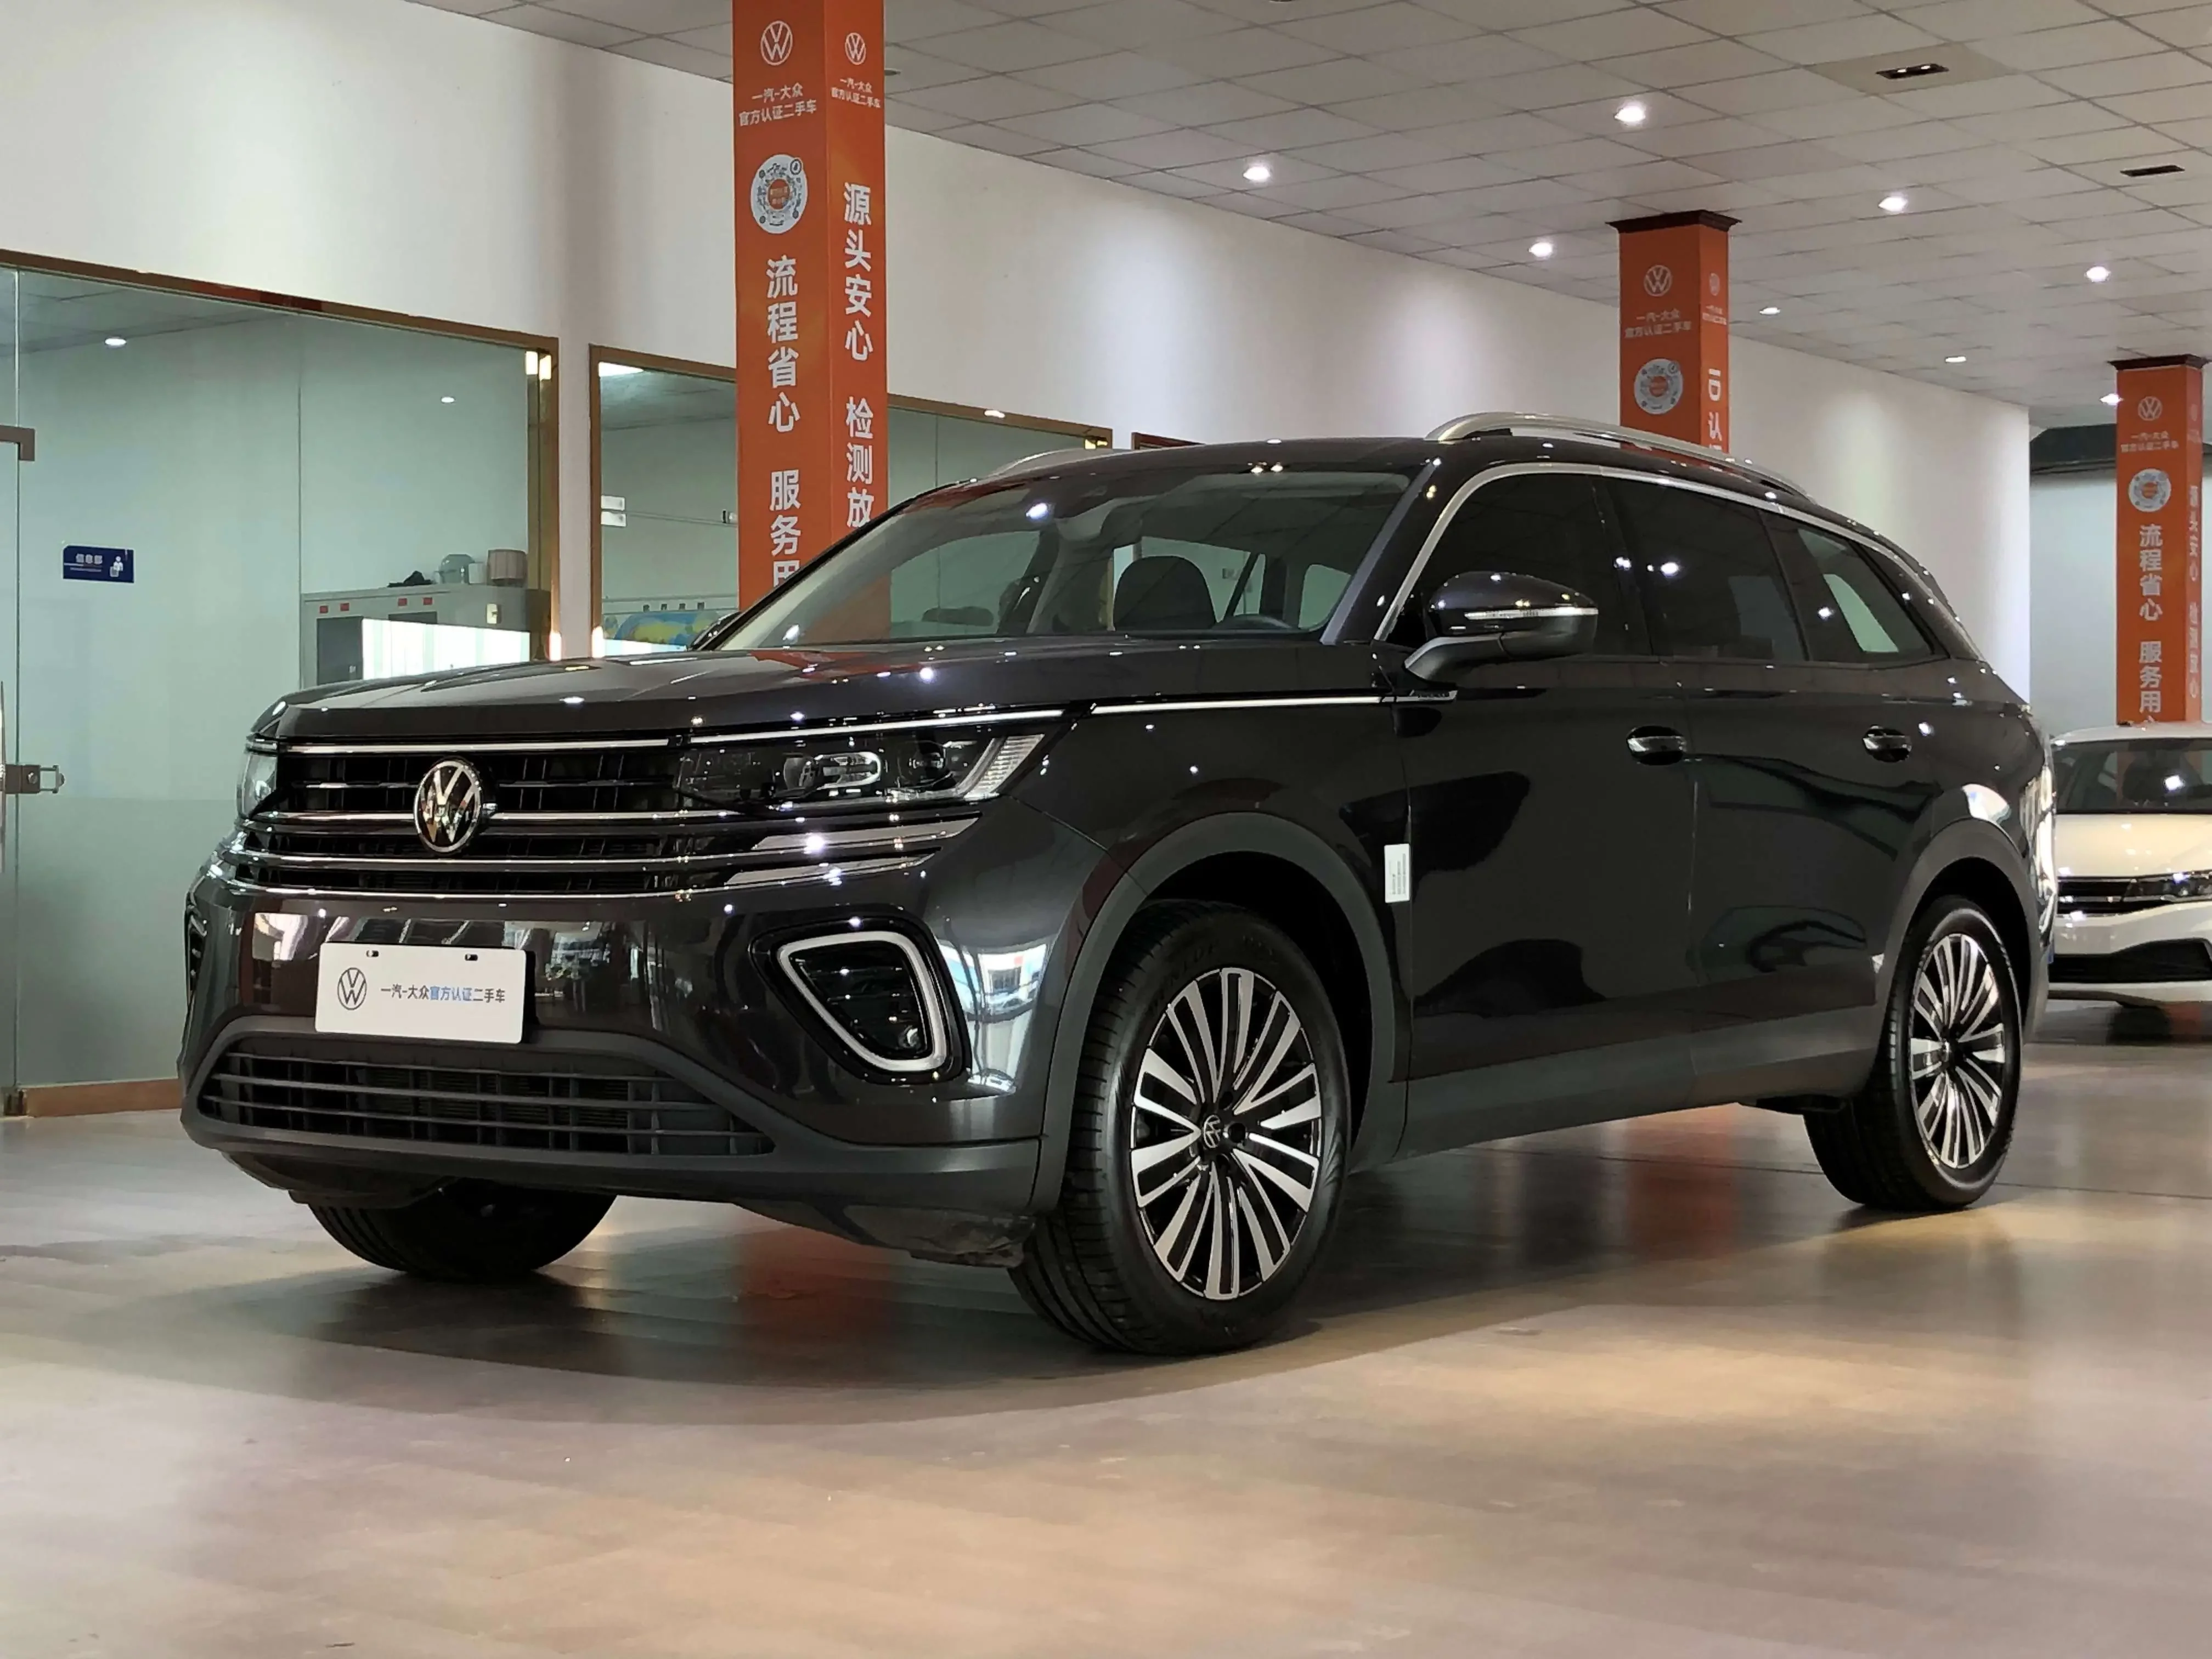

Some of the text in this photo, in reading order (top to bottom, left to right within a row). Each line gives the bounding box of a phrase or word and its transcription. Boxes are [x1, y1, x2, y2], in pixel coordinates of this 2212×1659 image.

[739, 99, 817, 127] 官方认证二手车
[752, 82, 803, 103] 一汽-大众
[766, 255, 799, 433] 流程省心
[844, 182, 874, 528] 源头安心 检测放
[2139, 523, 2163, 723] 流程省心 服务用
[381, 983, 505, 1003] 一汽-大众官方认证二手车
